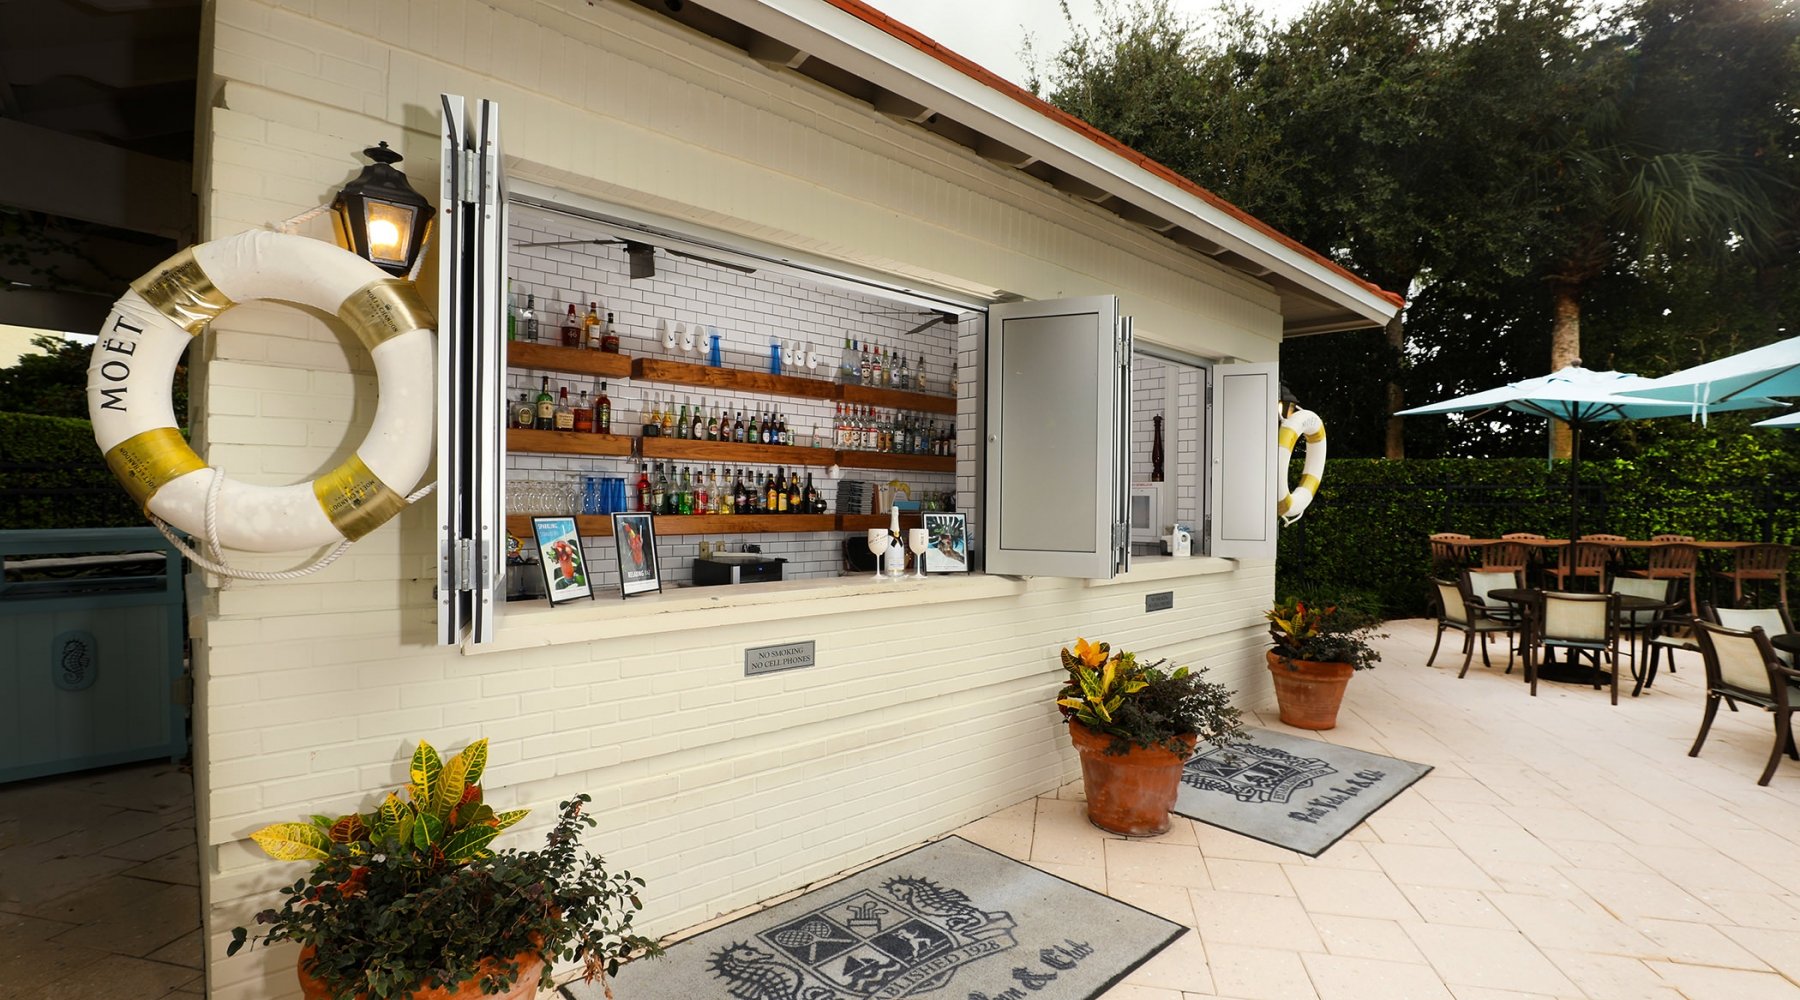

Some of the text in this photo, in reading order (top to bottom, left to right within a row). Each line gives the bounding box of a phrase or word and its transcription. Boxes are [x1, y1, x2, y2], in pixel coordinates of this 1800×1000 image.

[100, 315, 143, 413] MOËT
[751, 655, 811, 670] NO CELL PHONES
[758, 647, 804, 660] NO SMOKING
[962, 939, 1001, 958] 1928
[1011, 967, 1058, 990] &
[1039, 938, 1095, 971] Club
